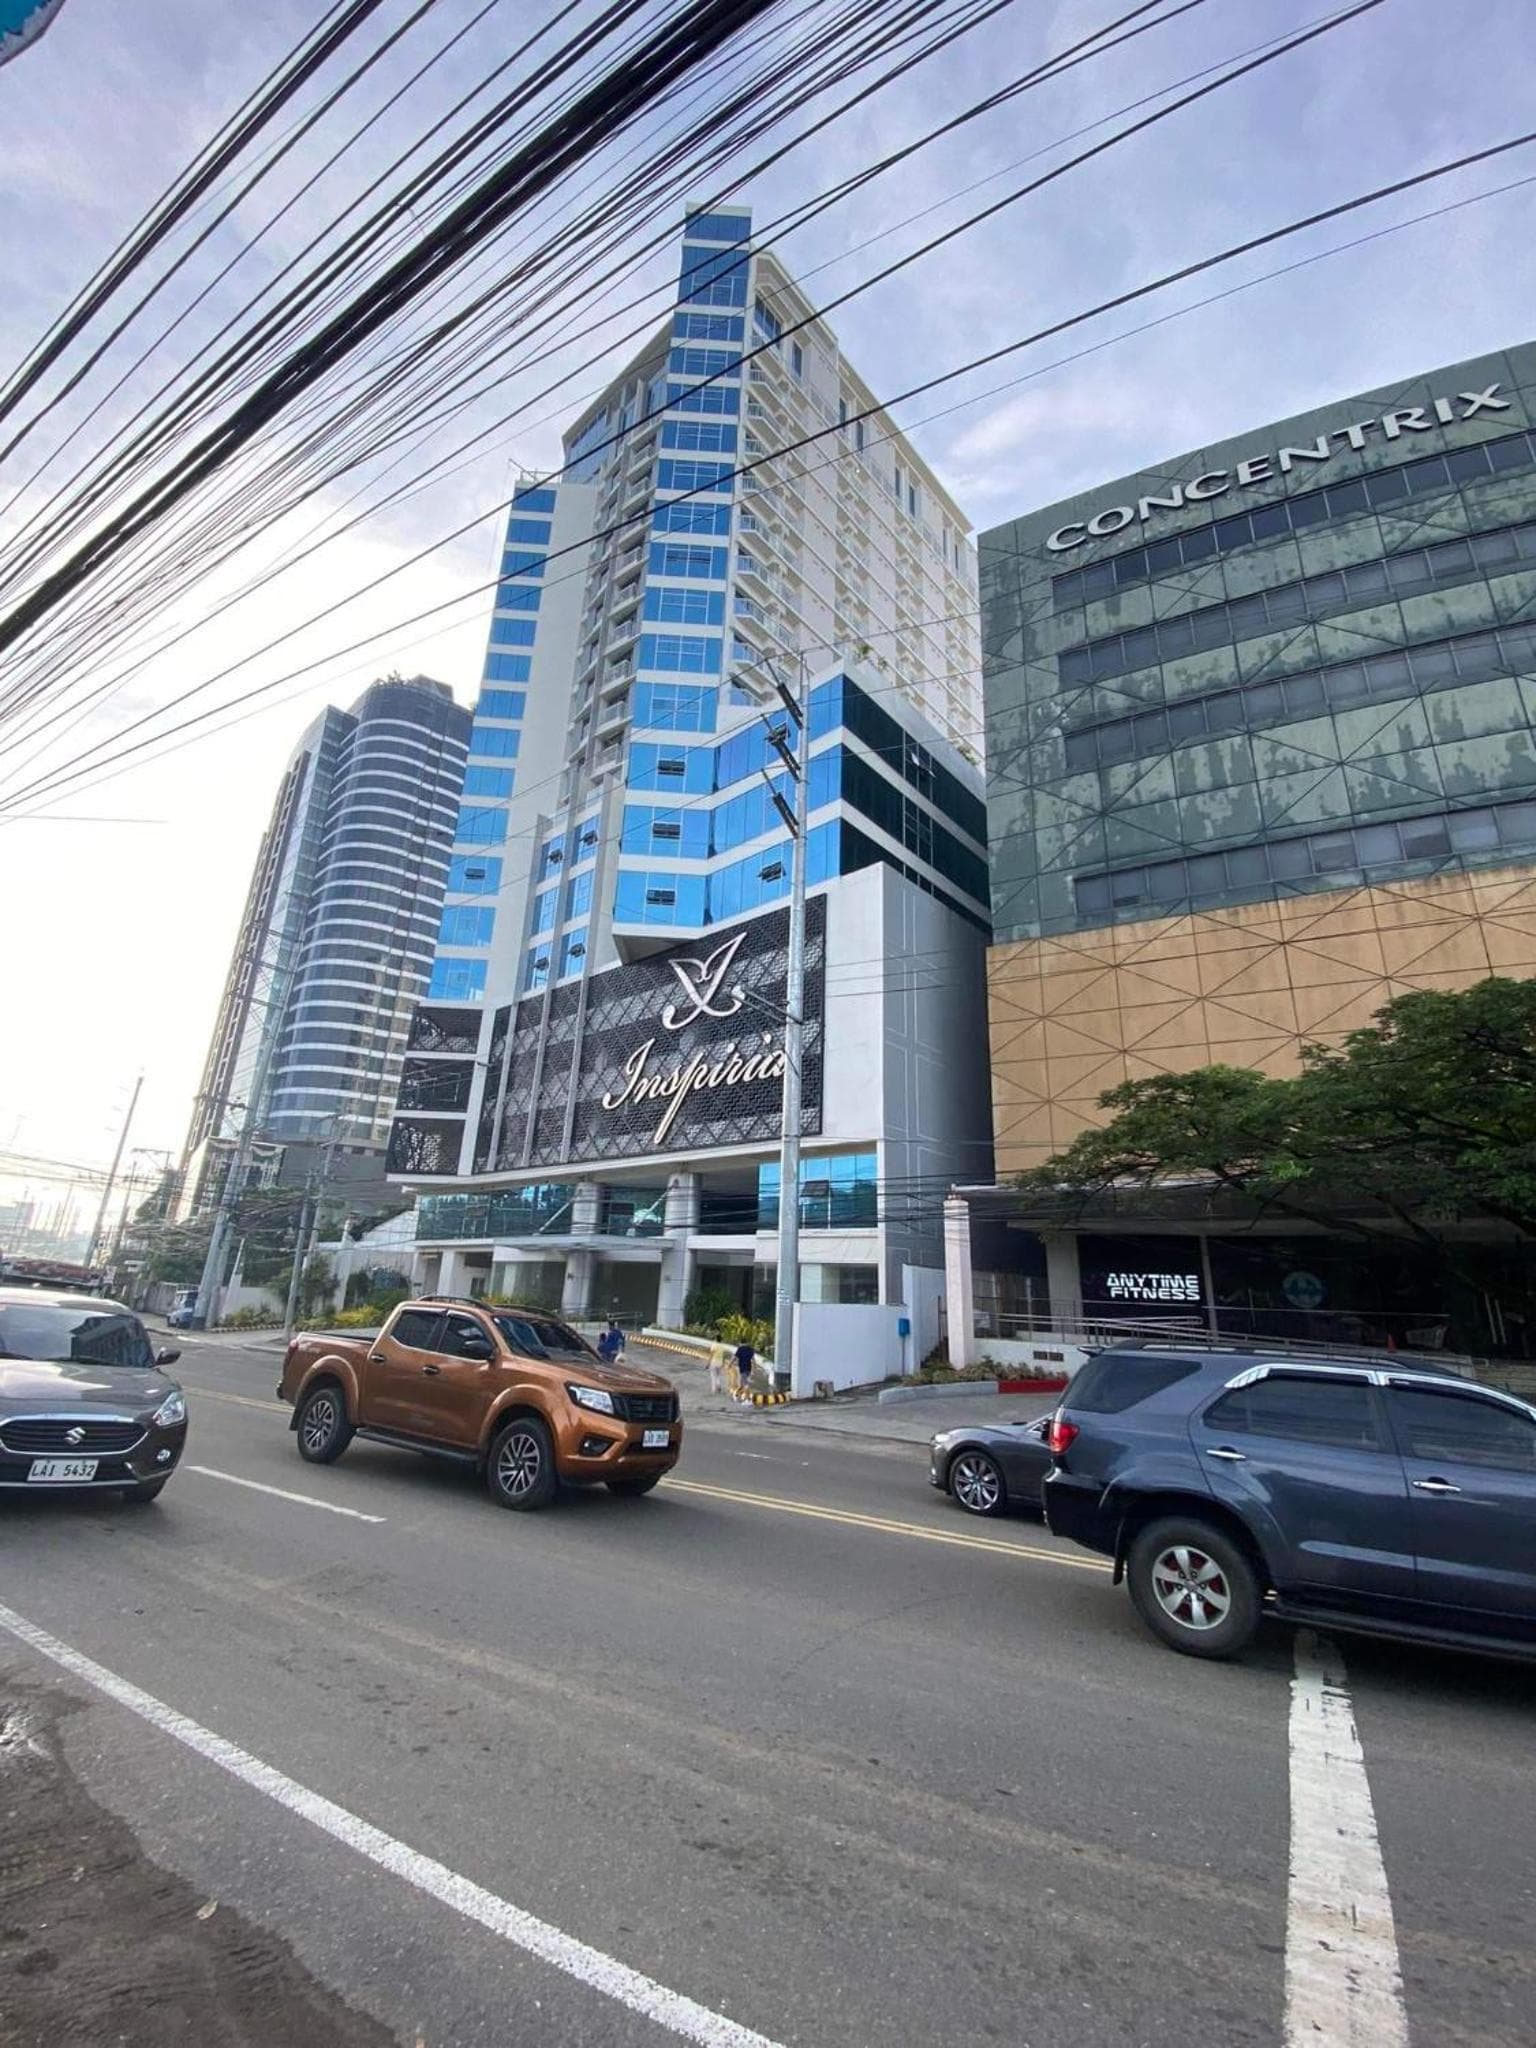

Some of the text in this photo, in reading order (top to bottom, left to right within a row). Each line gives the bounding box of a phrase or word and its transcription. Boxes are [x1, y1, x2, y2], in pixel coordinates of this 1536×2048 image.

[1046, 383, 1511, 552] CONCENTRIX
[602, 1032, 787, 1144] Inspiria
[1106, 1273, 1199, 1289] ANYTIME
[1110, 1287, 1201, 1300] FITNESS
[31, 1464, 96, 1477] LAI 5432
